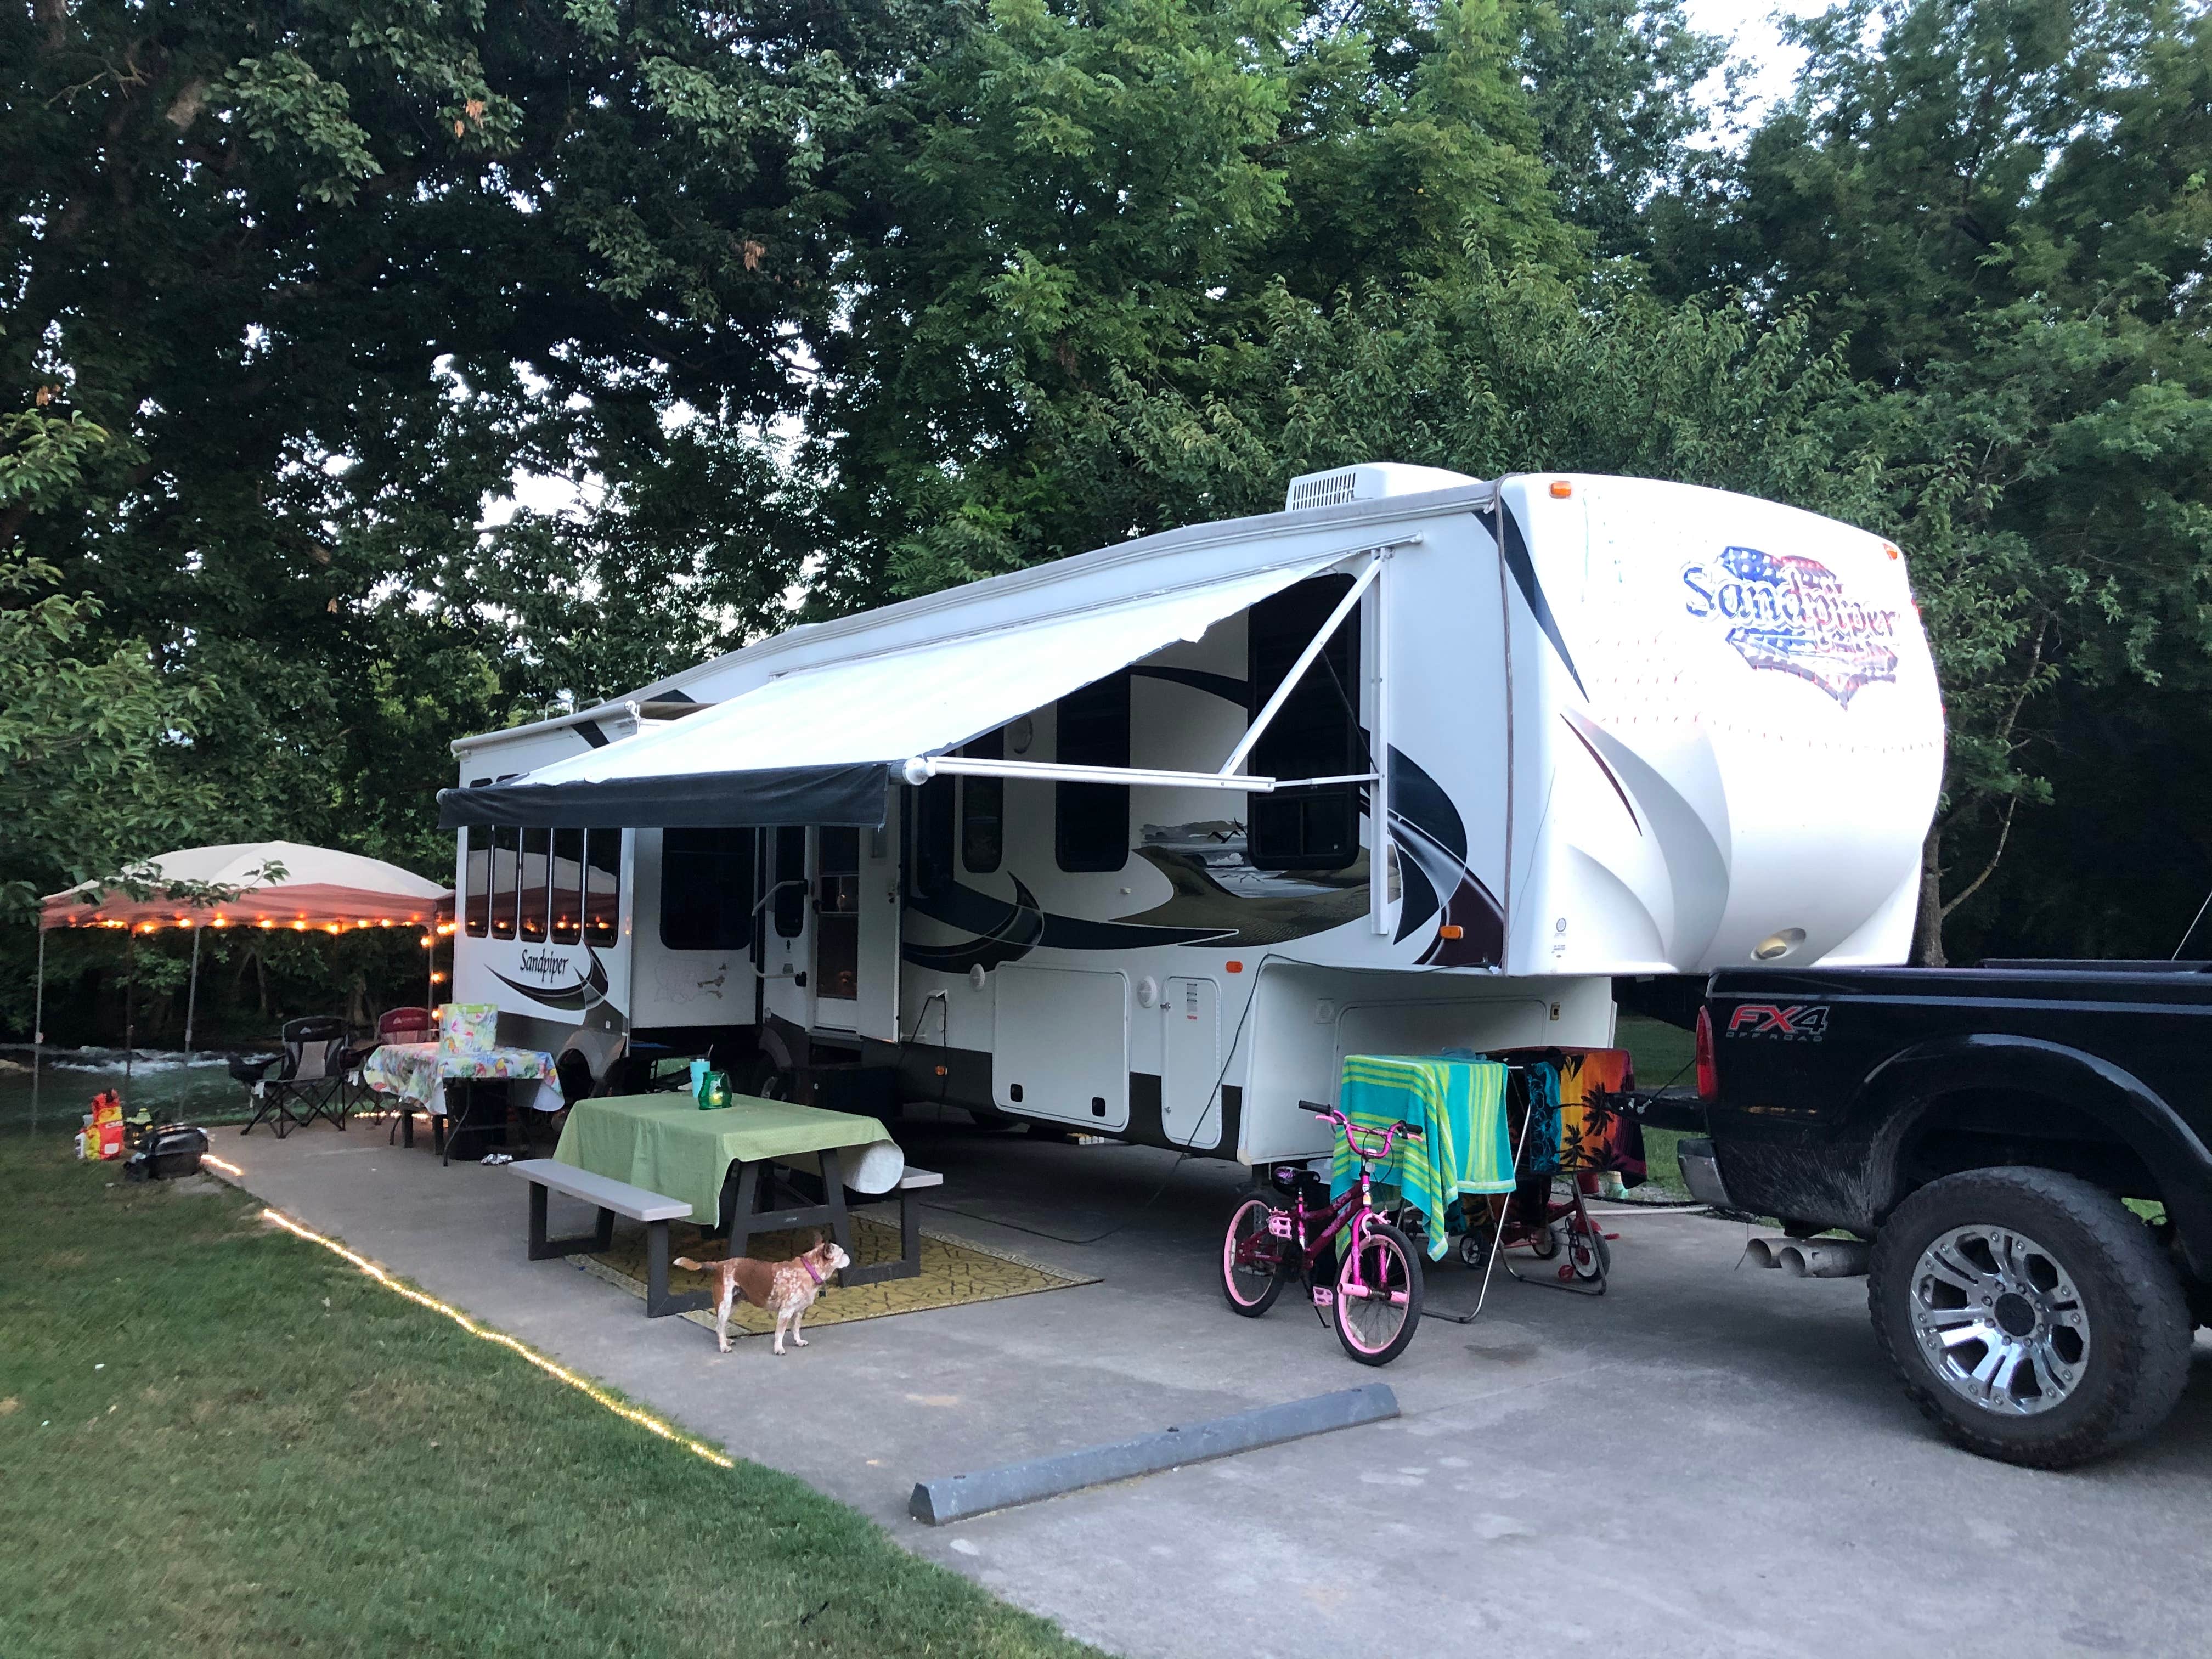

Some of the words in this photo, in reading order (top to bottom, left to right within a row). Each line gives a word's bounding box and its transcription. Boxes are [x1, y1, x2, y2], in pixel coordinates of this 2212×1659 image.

[1682, 566, 1896, 646] Sandpiper
[520, 948, 569, 983] Sandpiper
[1728, 1003, 1830, 1035] FX4
